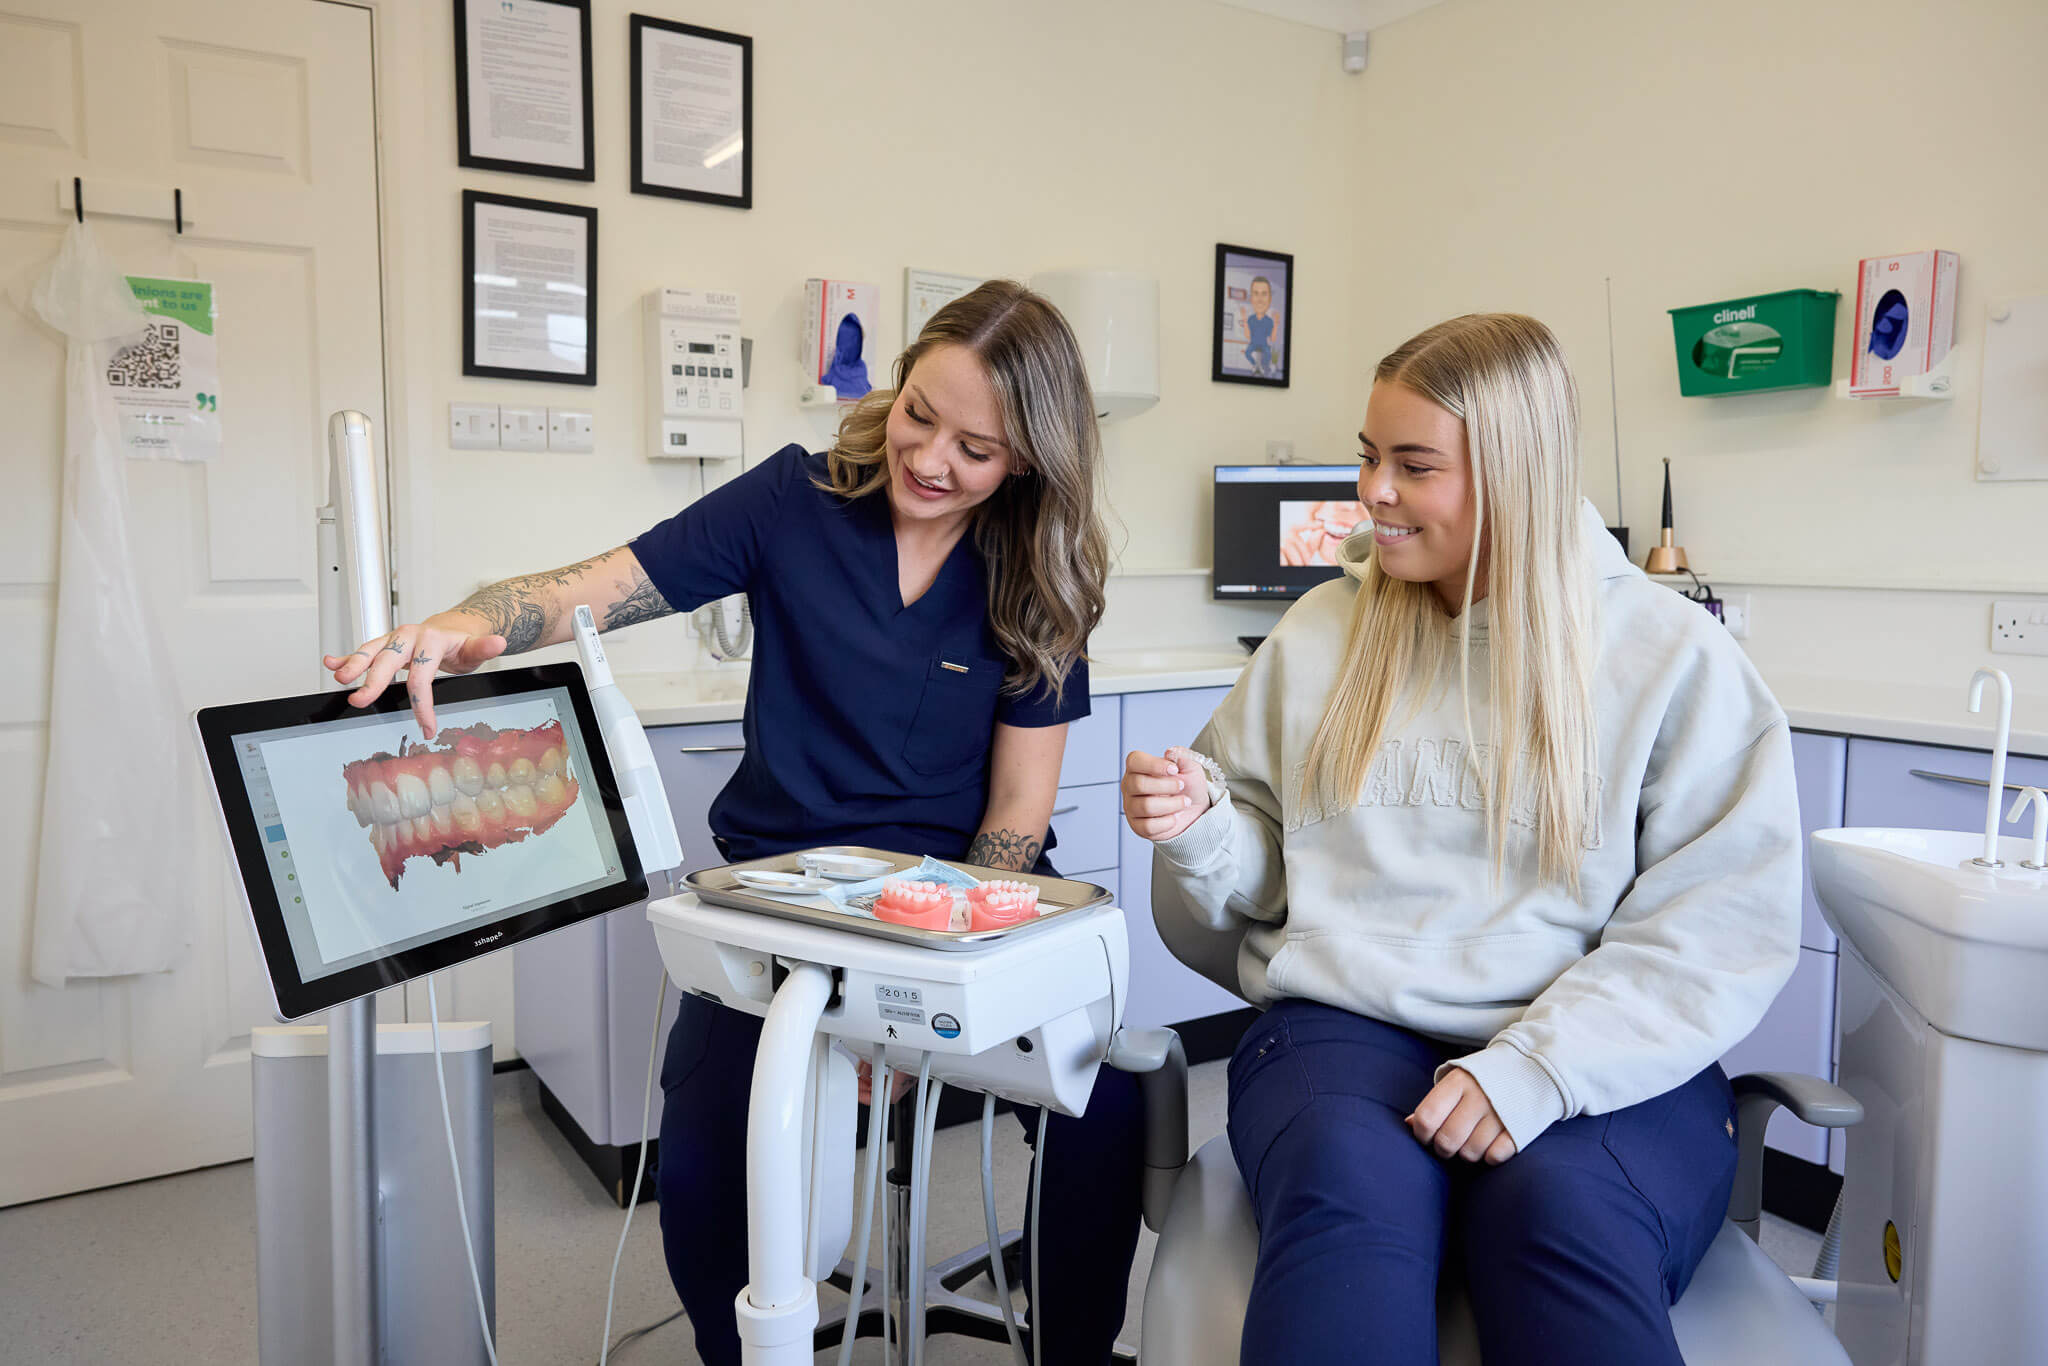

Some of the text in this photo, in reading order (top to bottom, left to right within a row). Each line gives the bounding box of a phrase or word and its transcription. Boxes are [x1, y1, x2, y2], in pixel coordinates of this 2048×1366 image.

[1889, 262, 1900, 272] S
[133, 284, 203, 300] inions are
[846, 288, 856, 300] M
[162, 299, 177, 309] to
[181, 302, 198, 311] us
[1713, 305, 1756, 324] clinell
[885, 988, 918, 1000] 2015
